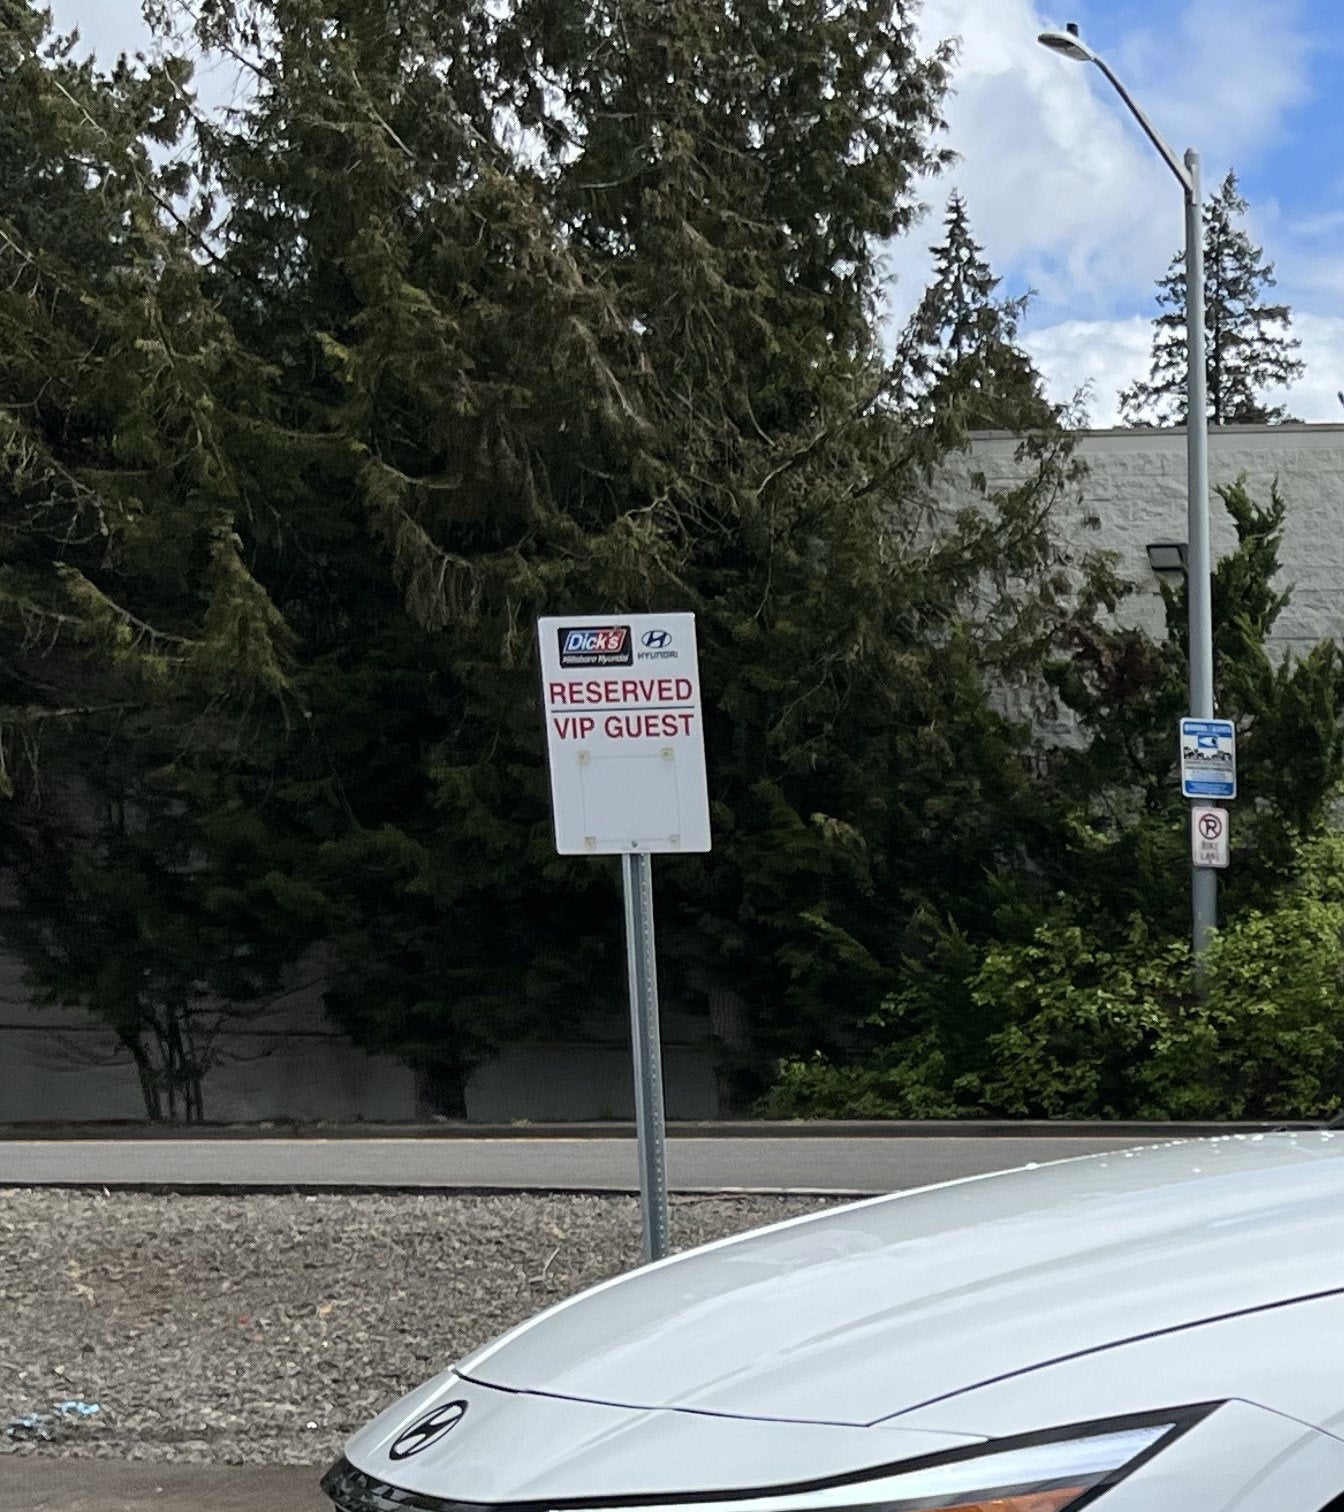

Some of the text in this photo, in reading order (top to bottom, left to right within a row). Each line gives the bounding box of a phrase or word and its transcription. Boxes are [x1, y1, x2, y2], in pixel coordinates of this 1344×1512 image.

[549, 680, 692, 704] RESERVED
[554, 713, 695, 740] VIP GUEST
